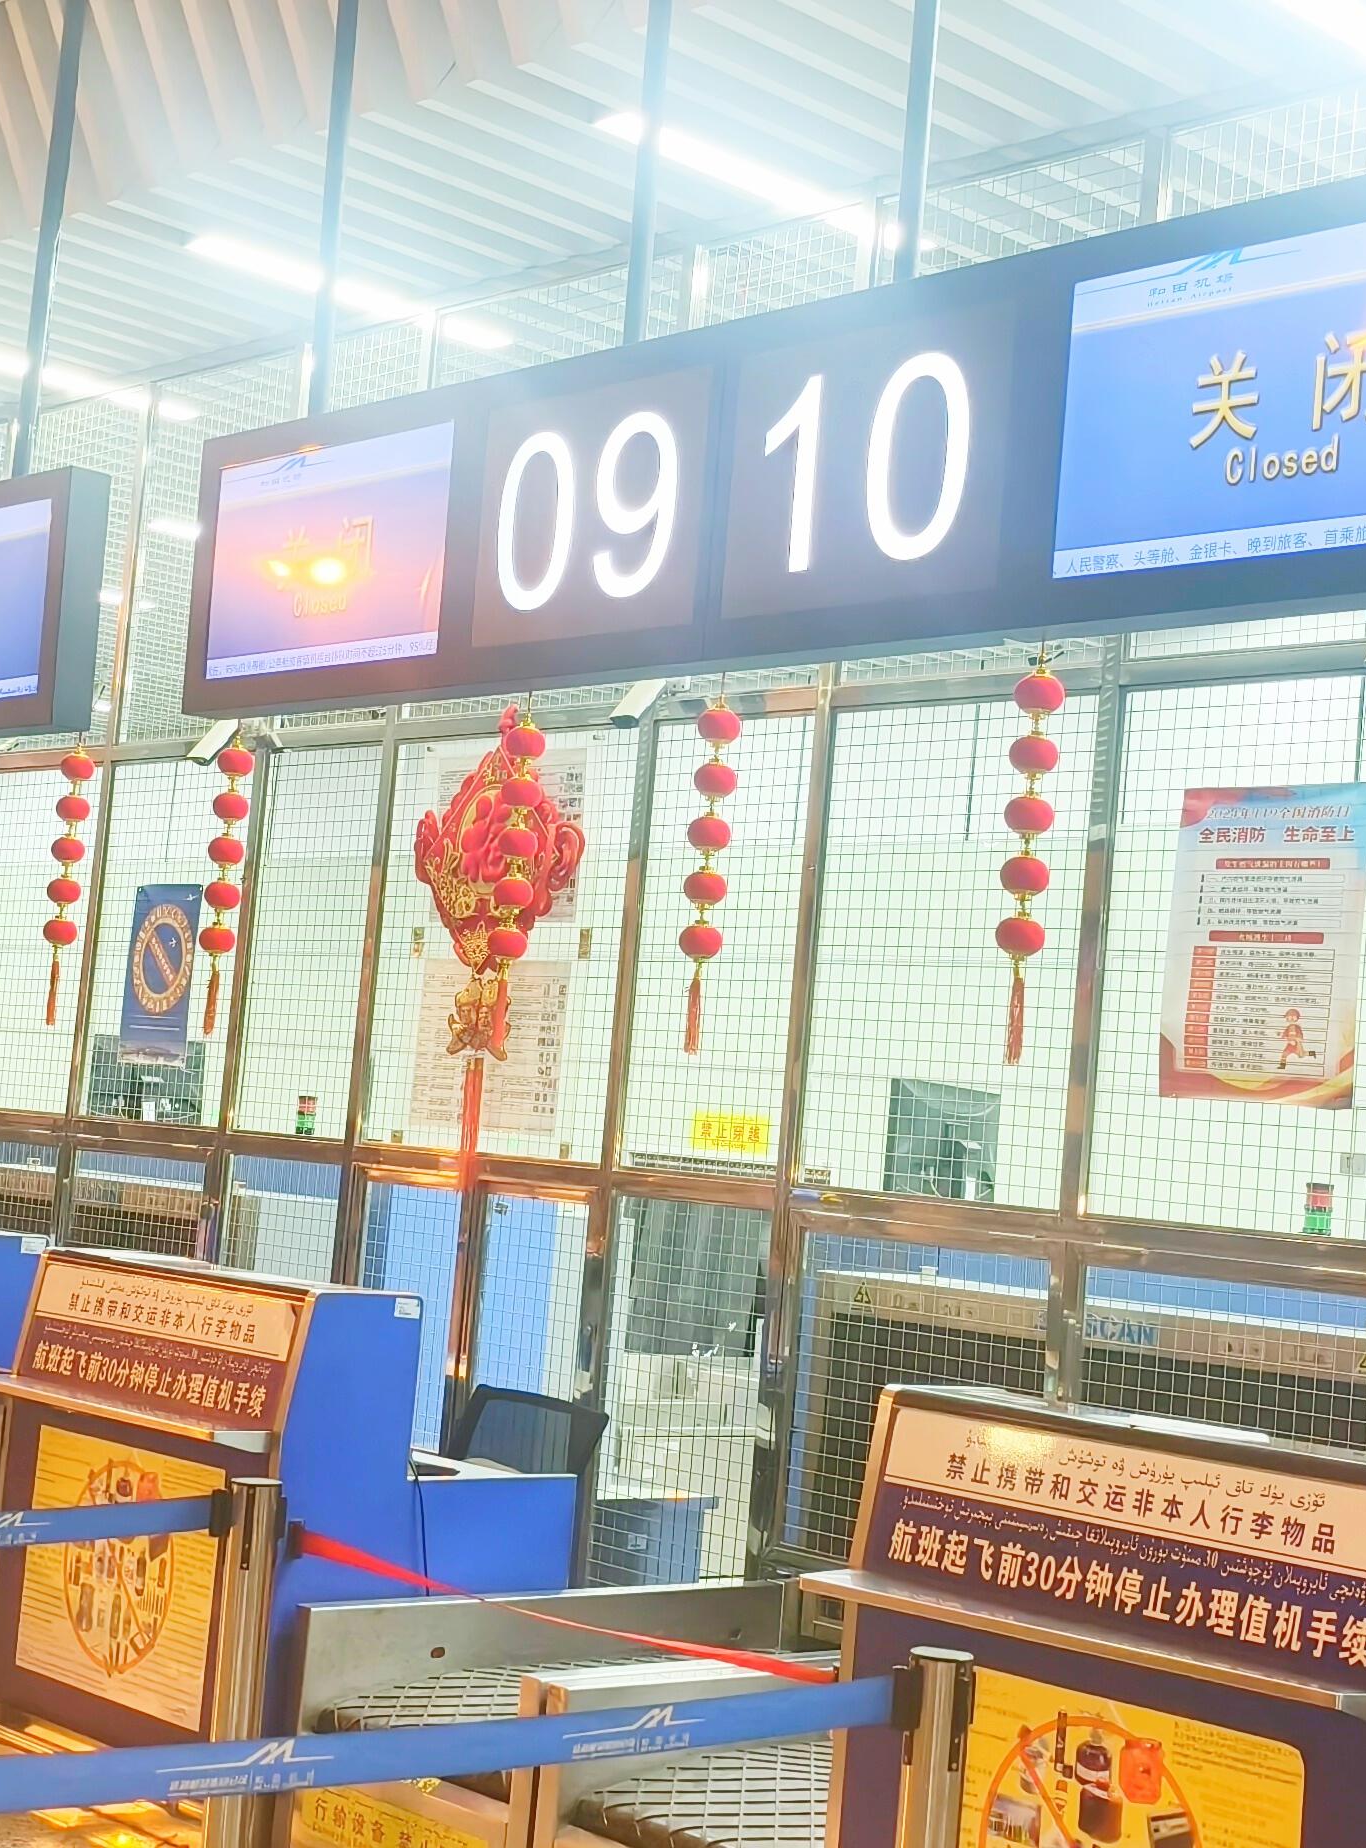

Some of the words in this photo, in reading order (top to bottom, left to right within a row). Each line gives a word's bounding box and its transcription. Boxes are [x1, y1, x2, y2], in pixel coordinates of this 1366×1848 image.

[497, 410, 680, 612] 09
[763, 352, 971, 574] 10
[1224, 433, 1341, 486] Closed
[1198, 826, 1267, 844] 全民消防
[1283, 825, 1355, 844] 生命至上
[31, 1339, 268, 1419] 航班起飞前30分钟停止办理值机手续
[945, 1452, 1336, 1555] 禁止携带和交运非本人行李物品
[1203, 1550, 1219, 1569] 30
